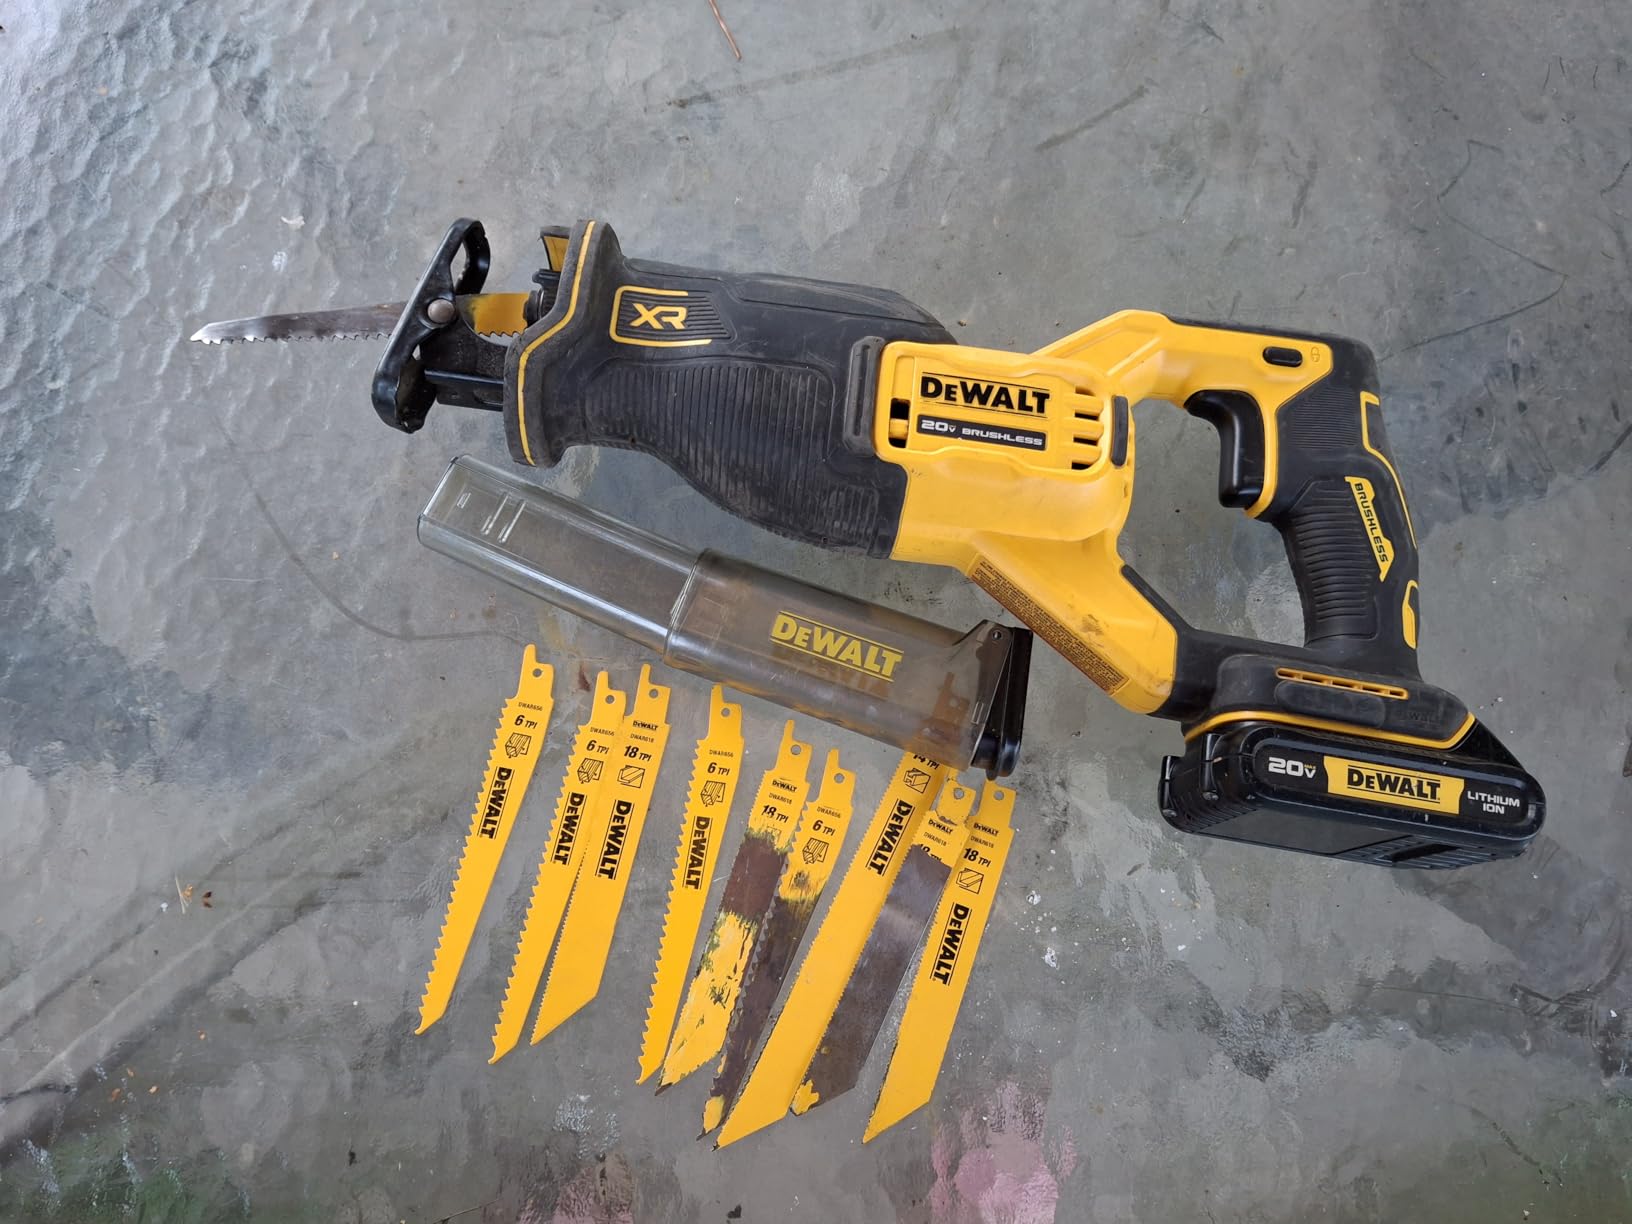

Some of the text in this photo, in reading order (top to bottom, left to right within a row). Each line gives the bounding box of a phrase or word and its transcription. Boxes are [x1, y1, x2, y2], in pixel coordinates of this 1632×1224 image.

[630, 303, 688, 330] XR
[962, 427, 1043, 446] BRUSHLESS
[1354, 482, 1389, 563] BRUSHLESS
[514, 714, 538, 729] 6 TPI
[586, 739, 610, 755] 6 TPI
[624, 745, 652, 762] 18 TPI
[707, 762, 731, 776] 6 TPI
[1467, 790, 1520, 808] LITHIUM
[776, 812, 789, 823] TPI
[1482, 803, 1505, 815] ION
[812, 819, 836, 836] 6 TPI
[963, 847, 992, 868] 18 TPI
